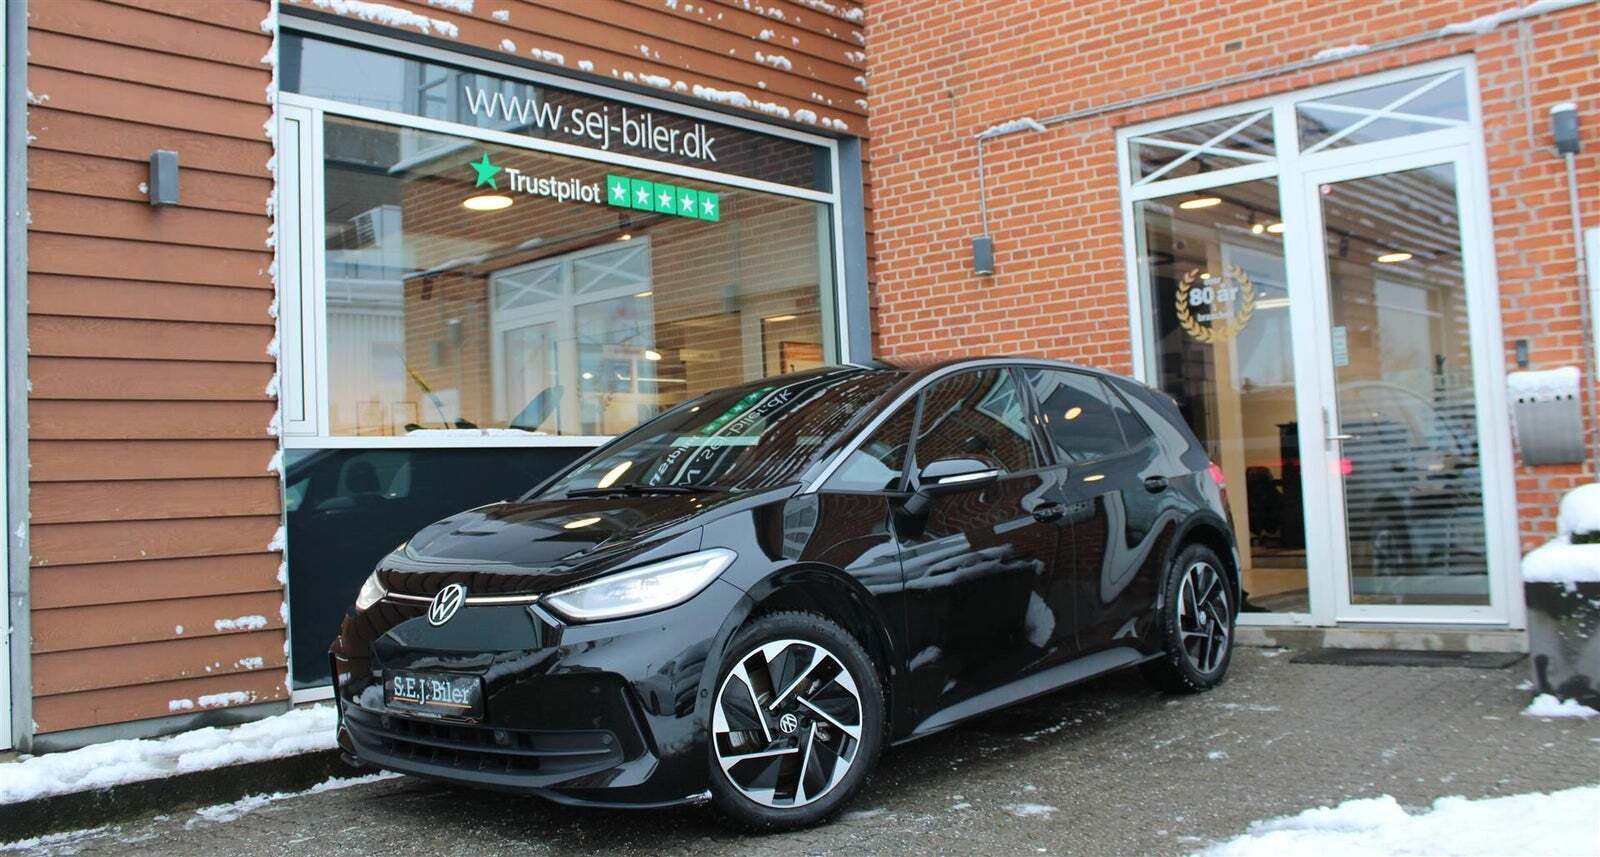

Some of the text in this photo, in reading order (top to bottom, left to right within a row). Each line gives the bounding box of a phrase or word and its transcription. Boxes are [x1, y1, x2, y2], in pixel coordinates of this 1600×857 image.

[465, 86, 717, 162] www.sej-biler.dk
[505, 168, 601, 203] Trustpilot
[1189, 287, 1214, 306] 80
[431, 680, 470, 704] Biler
